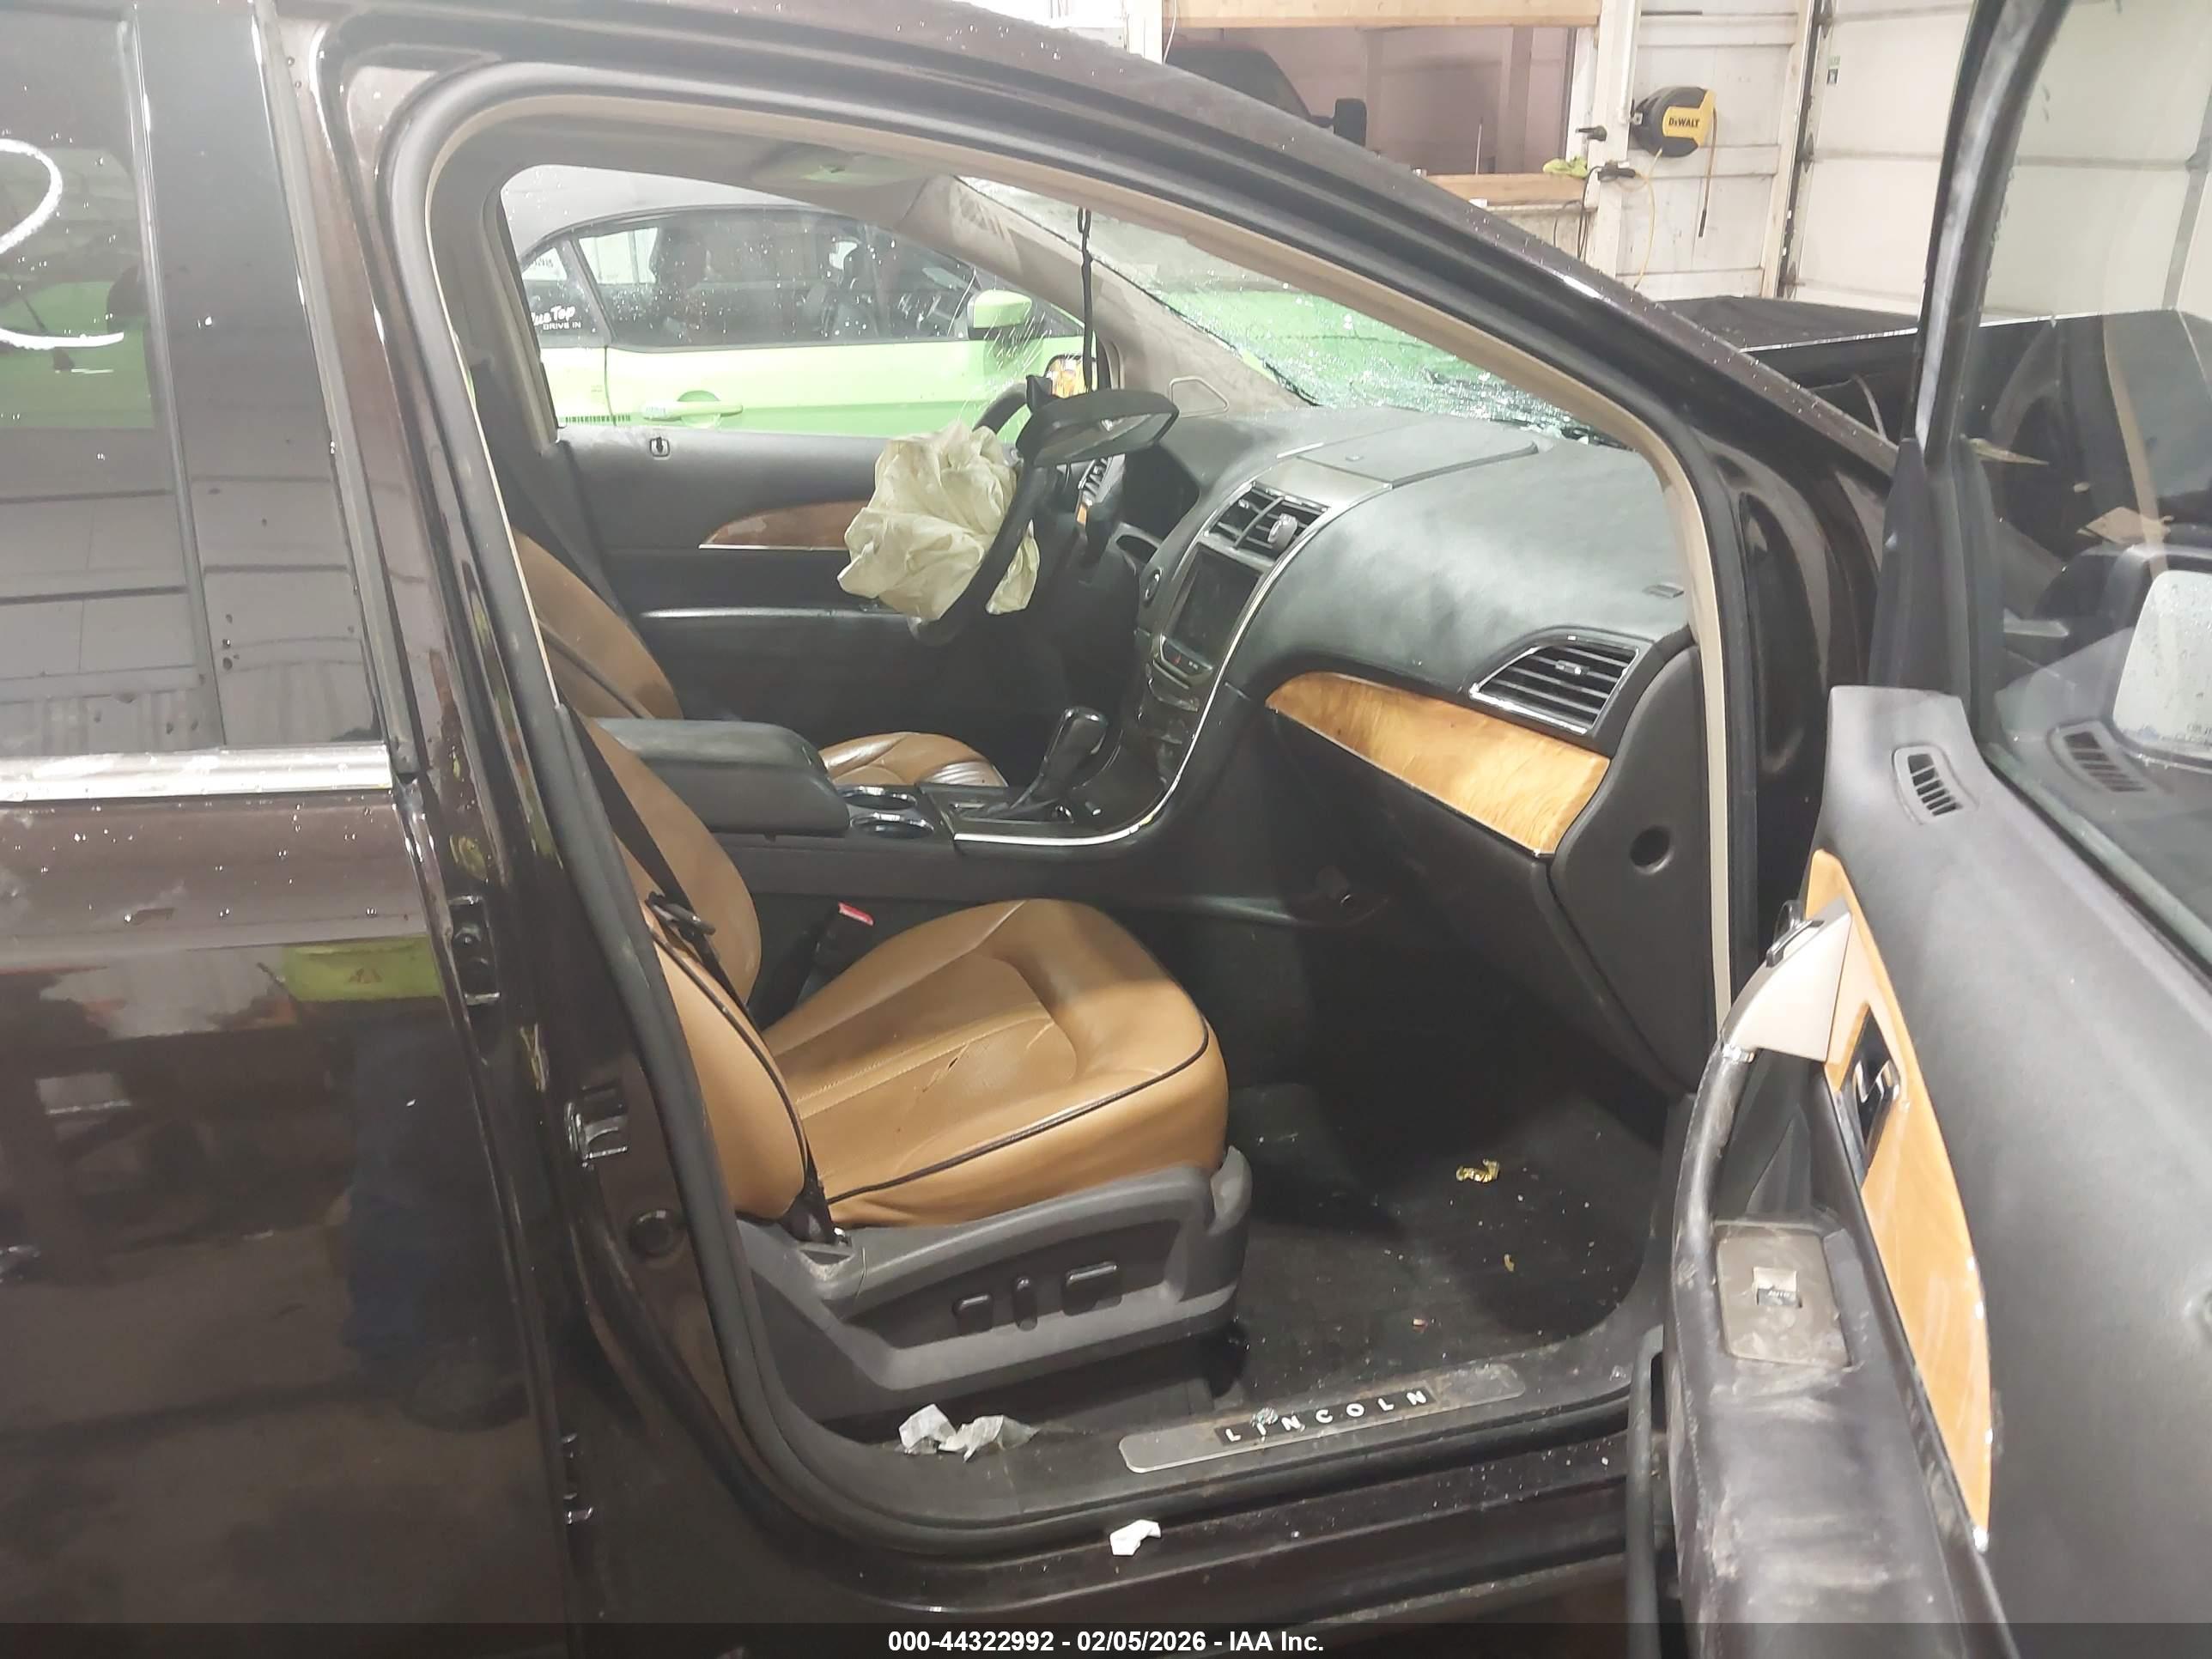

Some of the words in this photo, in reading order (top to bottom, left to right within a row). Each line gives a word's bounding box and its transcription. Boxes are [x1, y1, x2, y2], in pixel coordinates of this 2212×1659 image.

[550, 305, 575, 321] Top
[543, 321, 570, 331] DRIVE
[1225, 1390, 1426, 1442] LINCOLN
